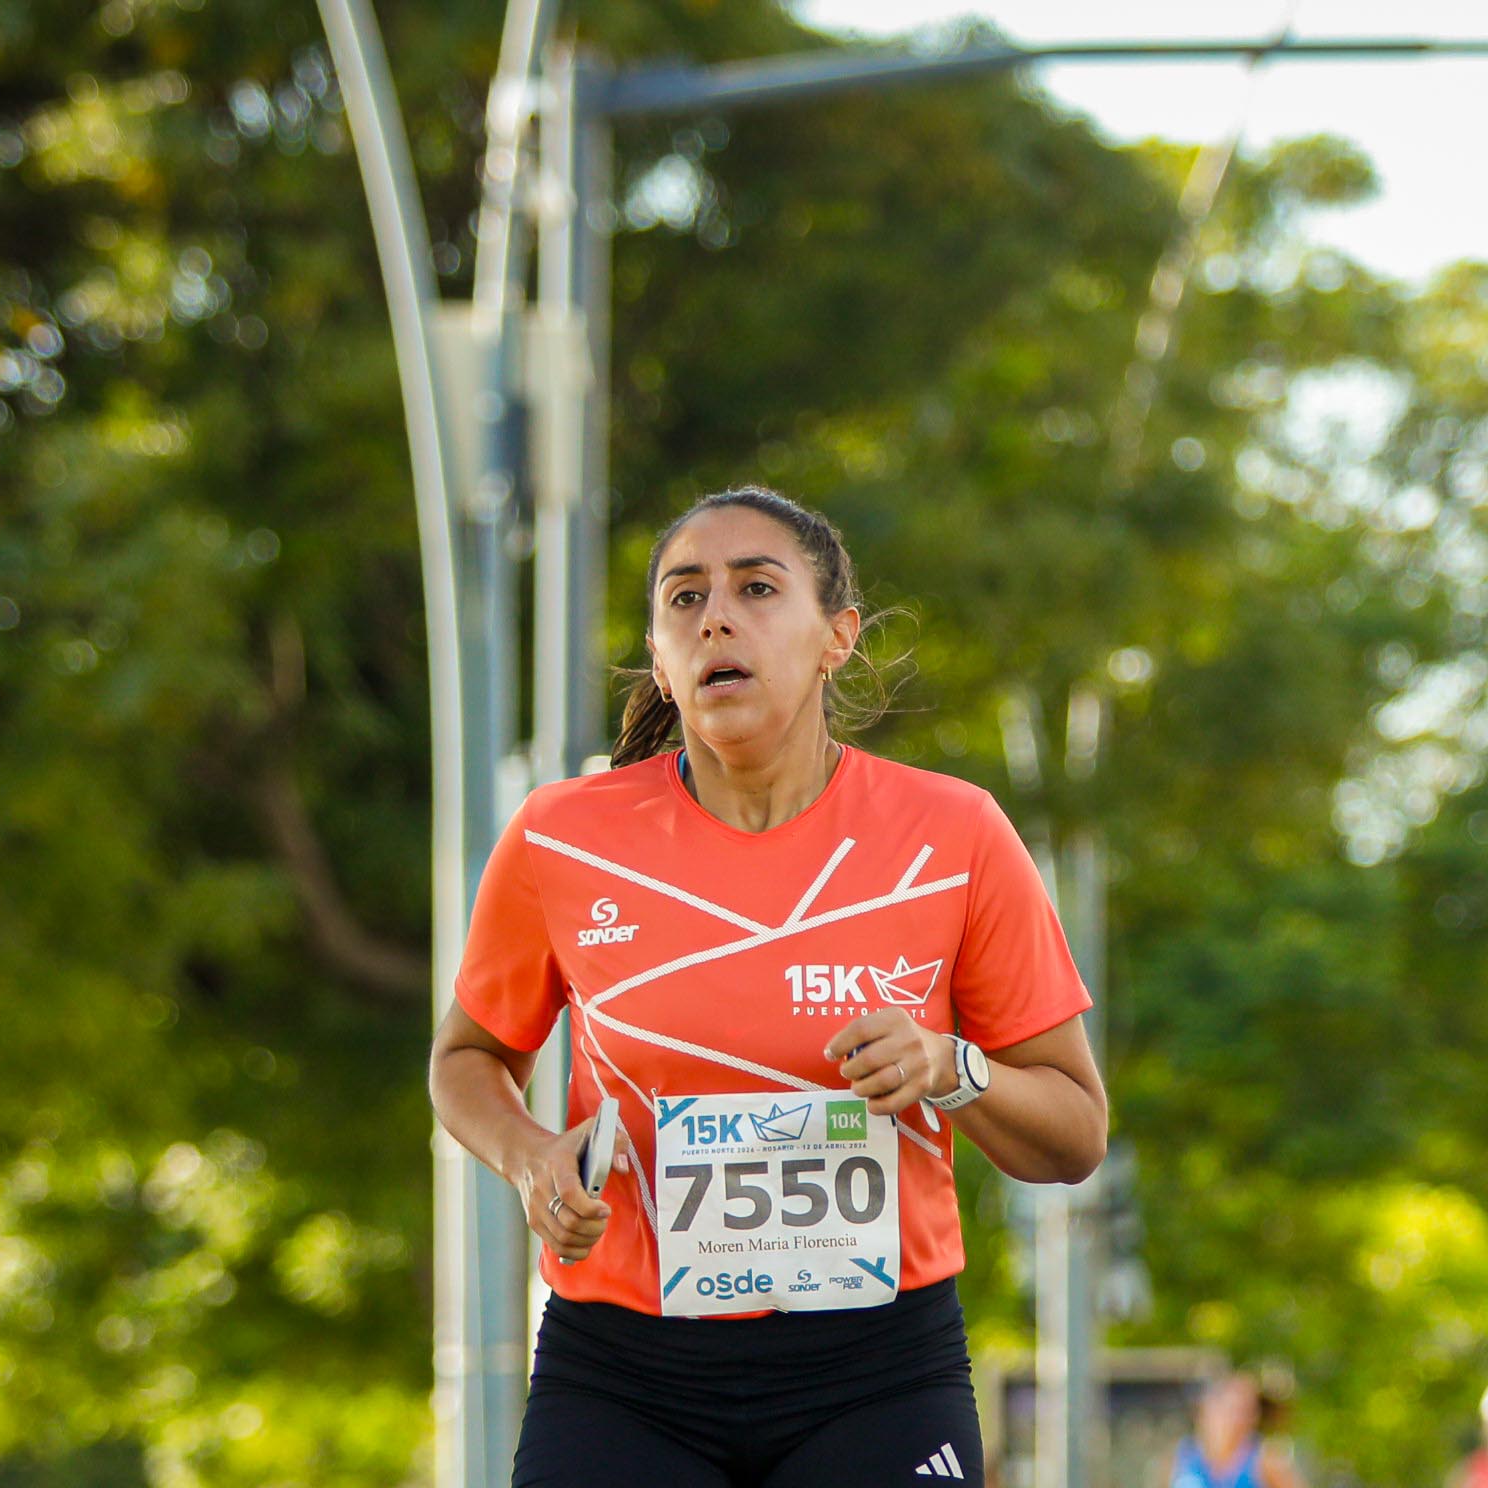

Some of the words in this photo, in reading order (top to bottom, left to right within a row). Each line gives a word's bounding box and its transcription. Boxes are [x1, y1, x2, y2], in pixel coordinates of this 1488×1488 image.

[784, 964, 867, 1003] 15K
[792, 1006, 869, 1017] PUERTO
[681, 1113, 744, 1146] 15K
[830, 1112, 862, 1129] 10K
[681, 1147, 709, 1156] PUERTO
[711, 1146, 736, 1154] NORTE
[762, 1144, 795, 1152] ROSARIO
[825, 1142, 847, 1150] ABRIL
[665, 1156, 886, 1232] 7550
[698, 1239, 744, 1254] Moren
[749, 1237, 789, 1251] Maria
[794, 1233, 858, 1249] Florencia
[696, 1268, 774, 1299] osde
